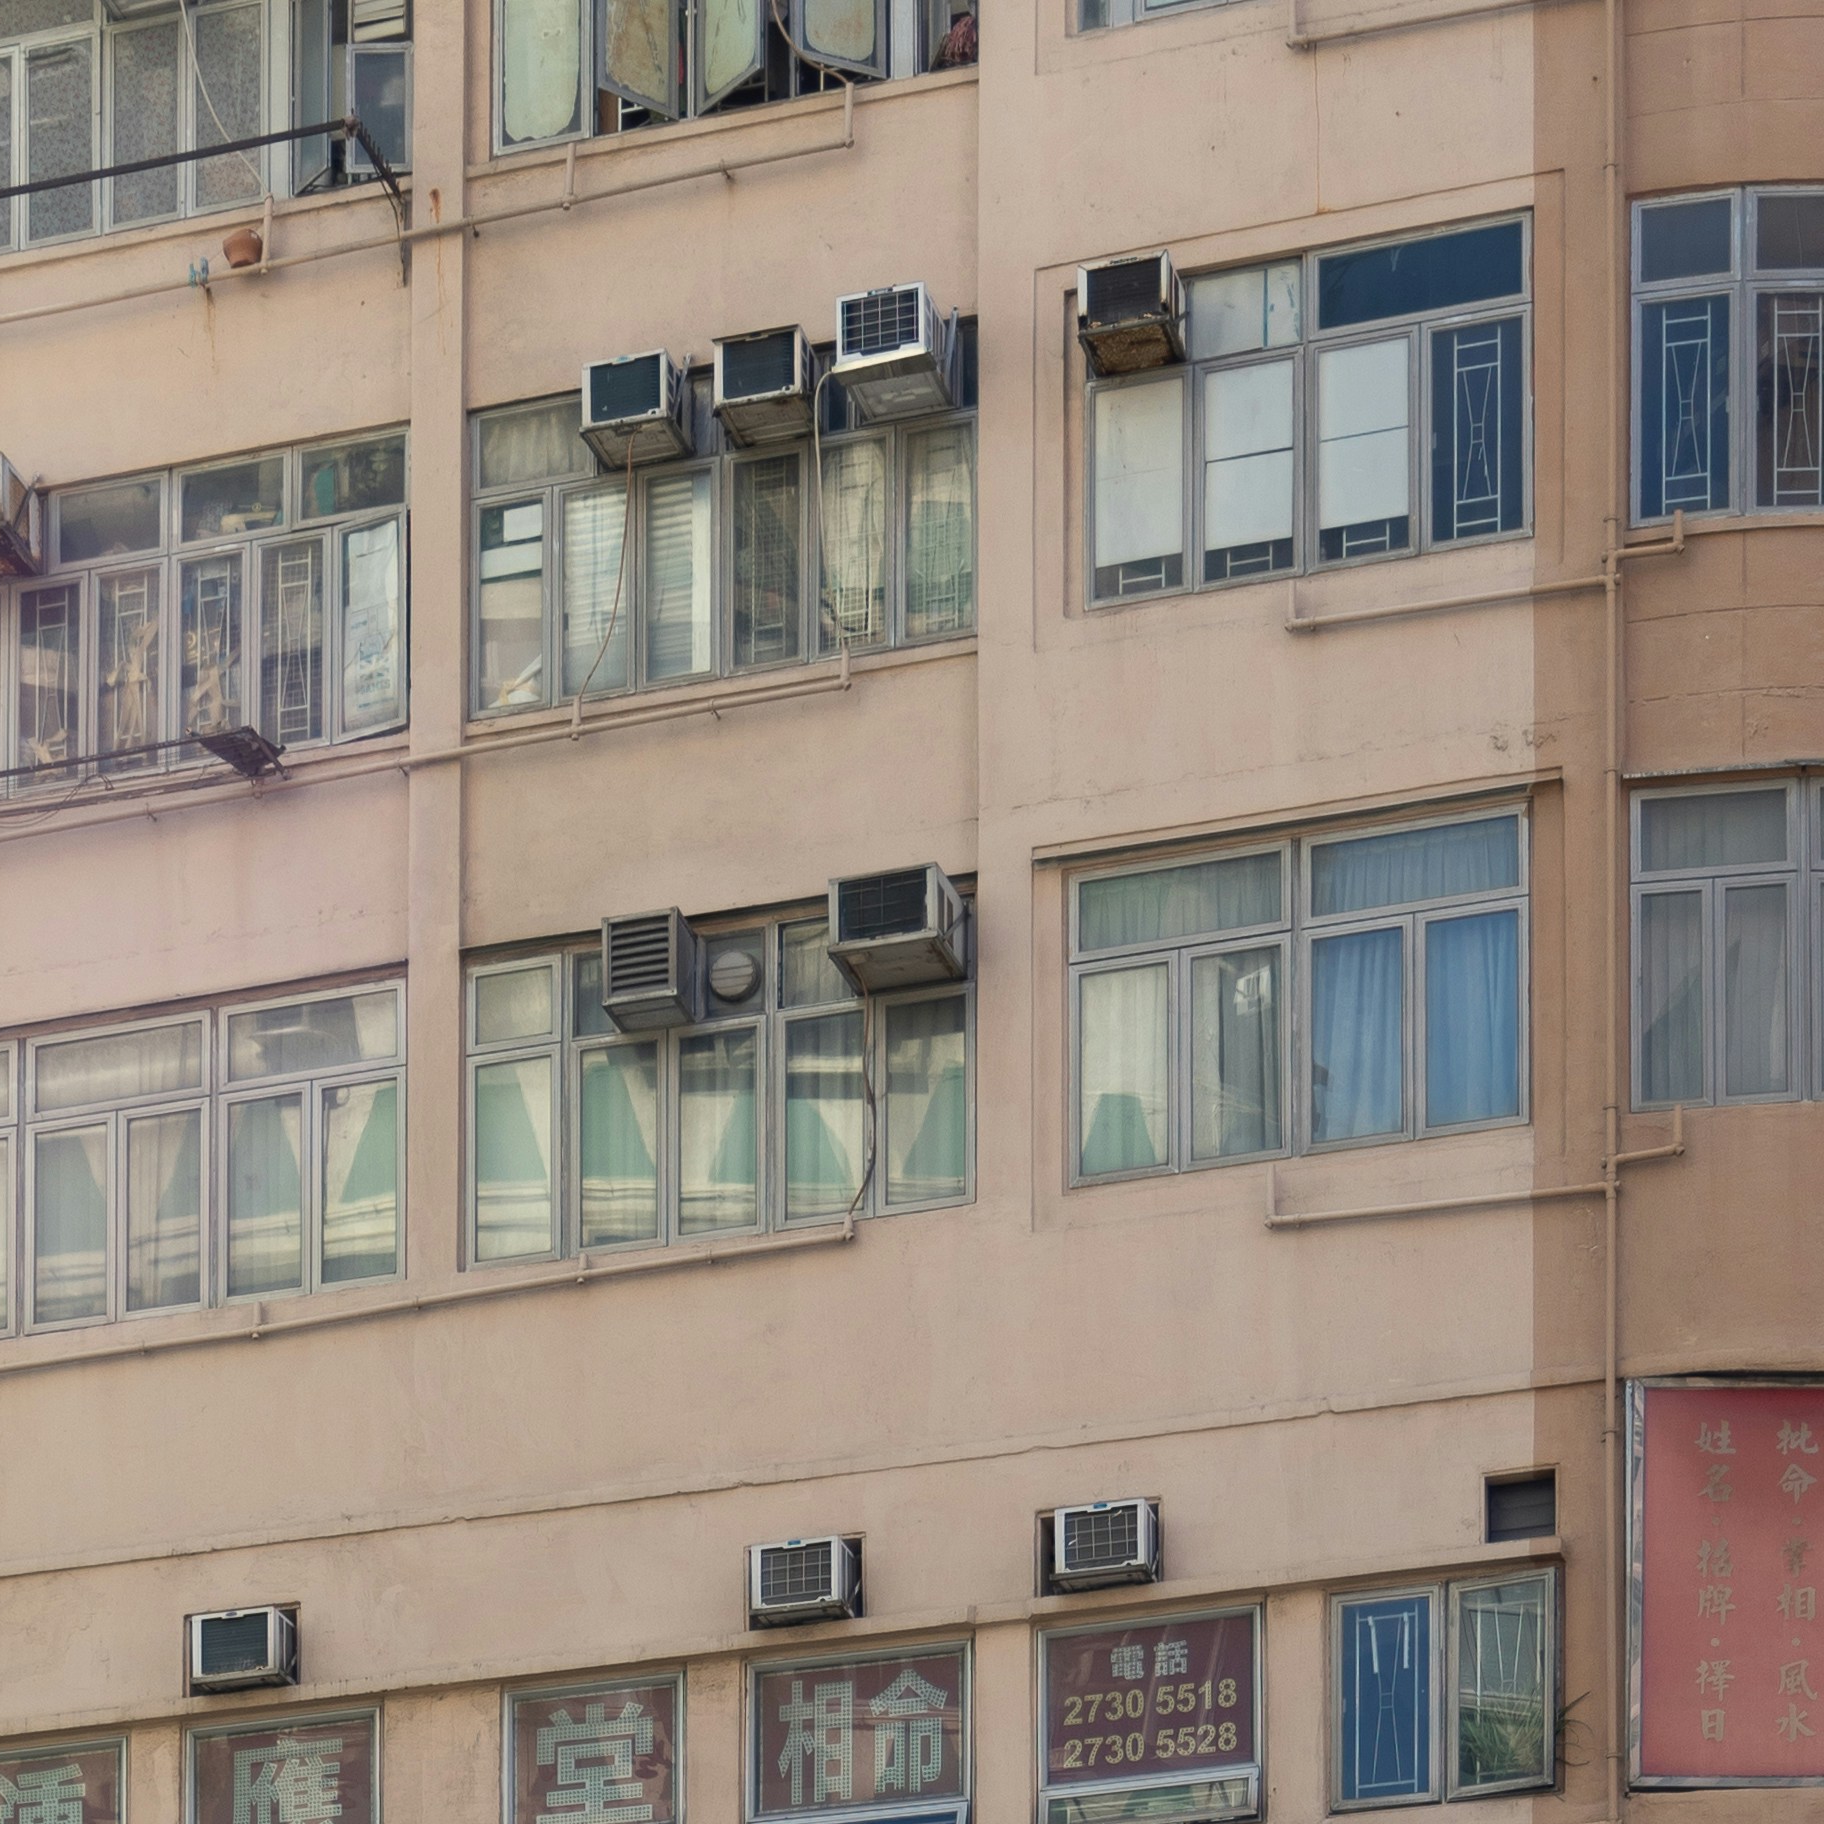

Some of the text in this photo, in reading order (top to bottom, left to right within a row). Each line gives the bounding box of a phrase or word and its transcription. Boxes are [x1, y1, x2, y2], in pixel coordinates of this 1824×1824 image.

[1110, 1640, 1188, 1680] 電話
[1063, 1678, 1238, 1727] 2730 5518
[1063, 1721, 1238, 1769] 2730 5528
